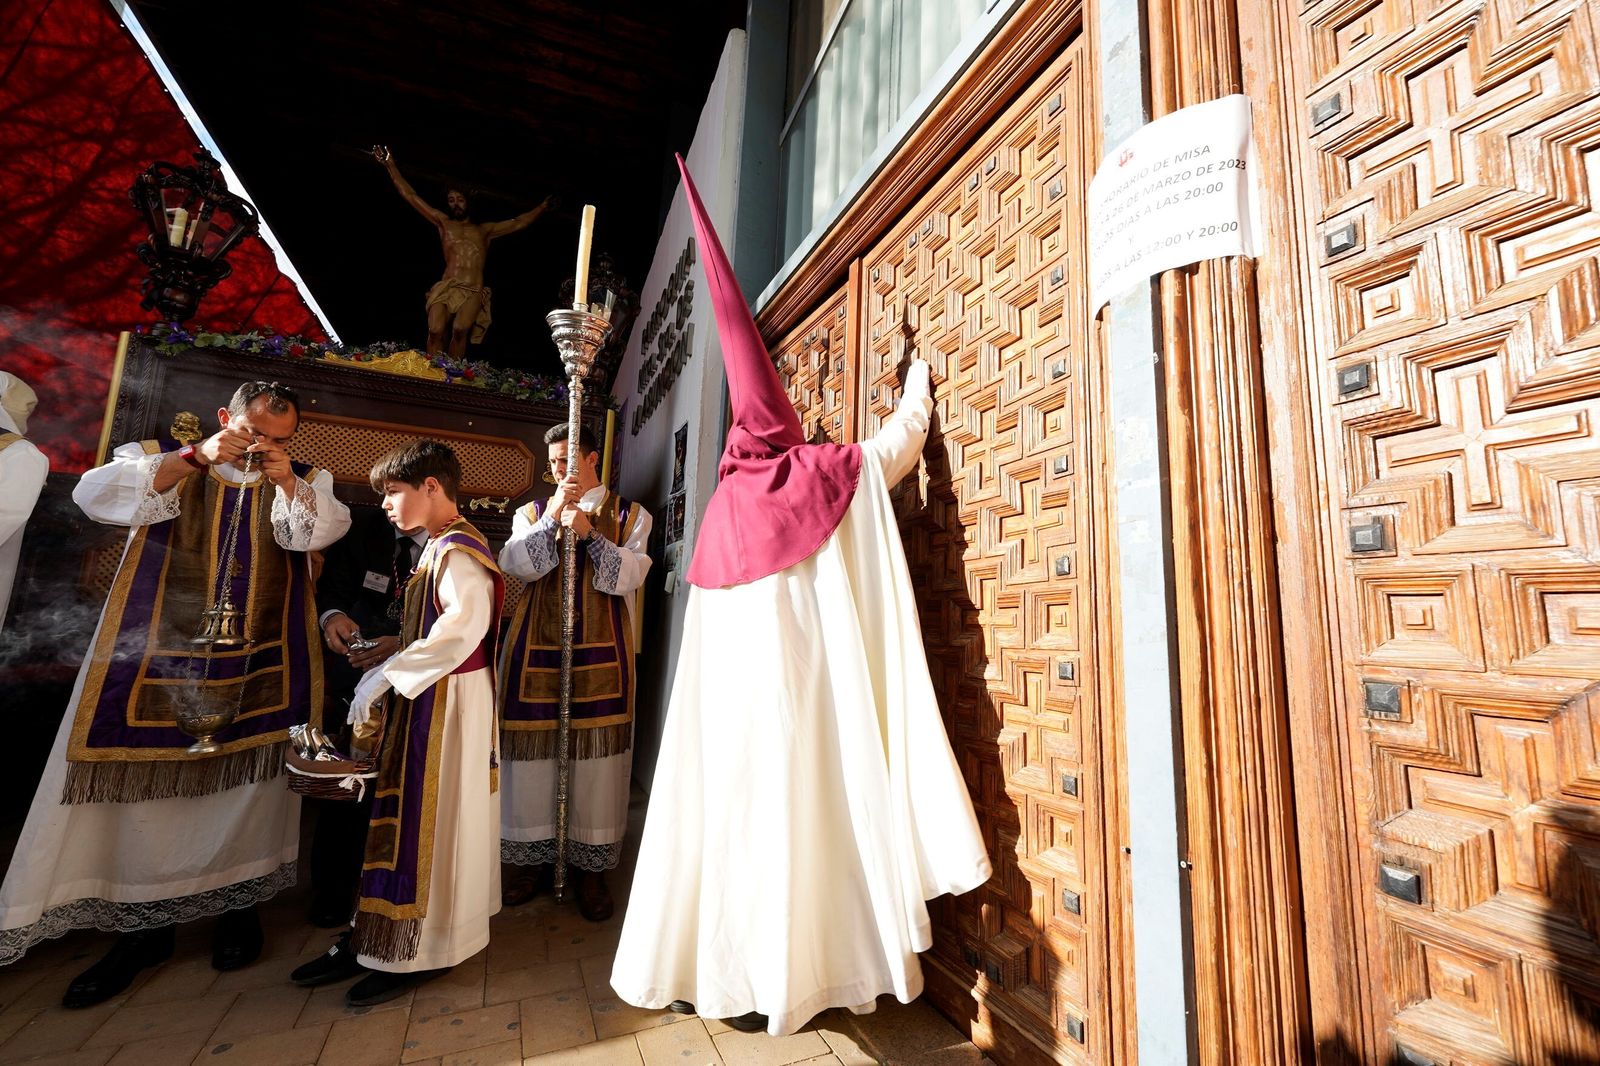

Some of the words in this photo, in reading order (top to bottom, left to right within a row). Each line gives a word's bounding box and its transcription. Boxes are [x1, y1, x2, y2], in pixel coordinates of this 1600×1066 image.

[1153, 158, 1169, 173] DE
[1174, 145, 1211, 164] MISA
[1111, 204, 1123, 218] 26
[1126, 194, 1139, 209] DE
[1142, 170, 1192, 197] MARZO
[1196, 164, 1214, 177] DE
[1218, 158, 1247, 171] 2023
[1116, 211, 1140, 234] DIAS
[1143, 205, 1152, 217] A
[1156, 193, 1181, 210] LAS
[1184, 181, 1224, 201] 20:00
[1124, 250, 1143, 268] LAS
[1147, 234, 1182, 254] 12:00
[1186, 230, 1195, 241] Y
[1198, 221, 1239, 238] 20:00
